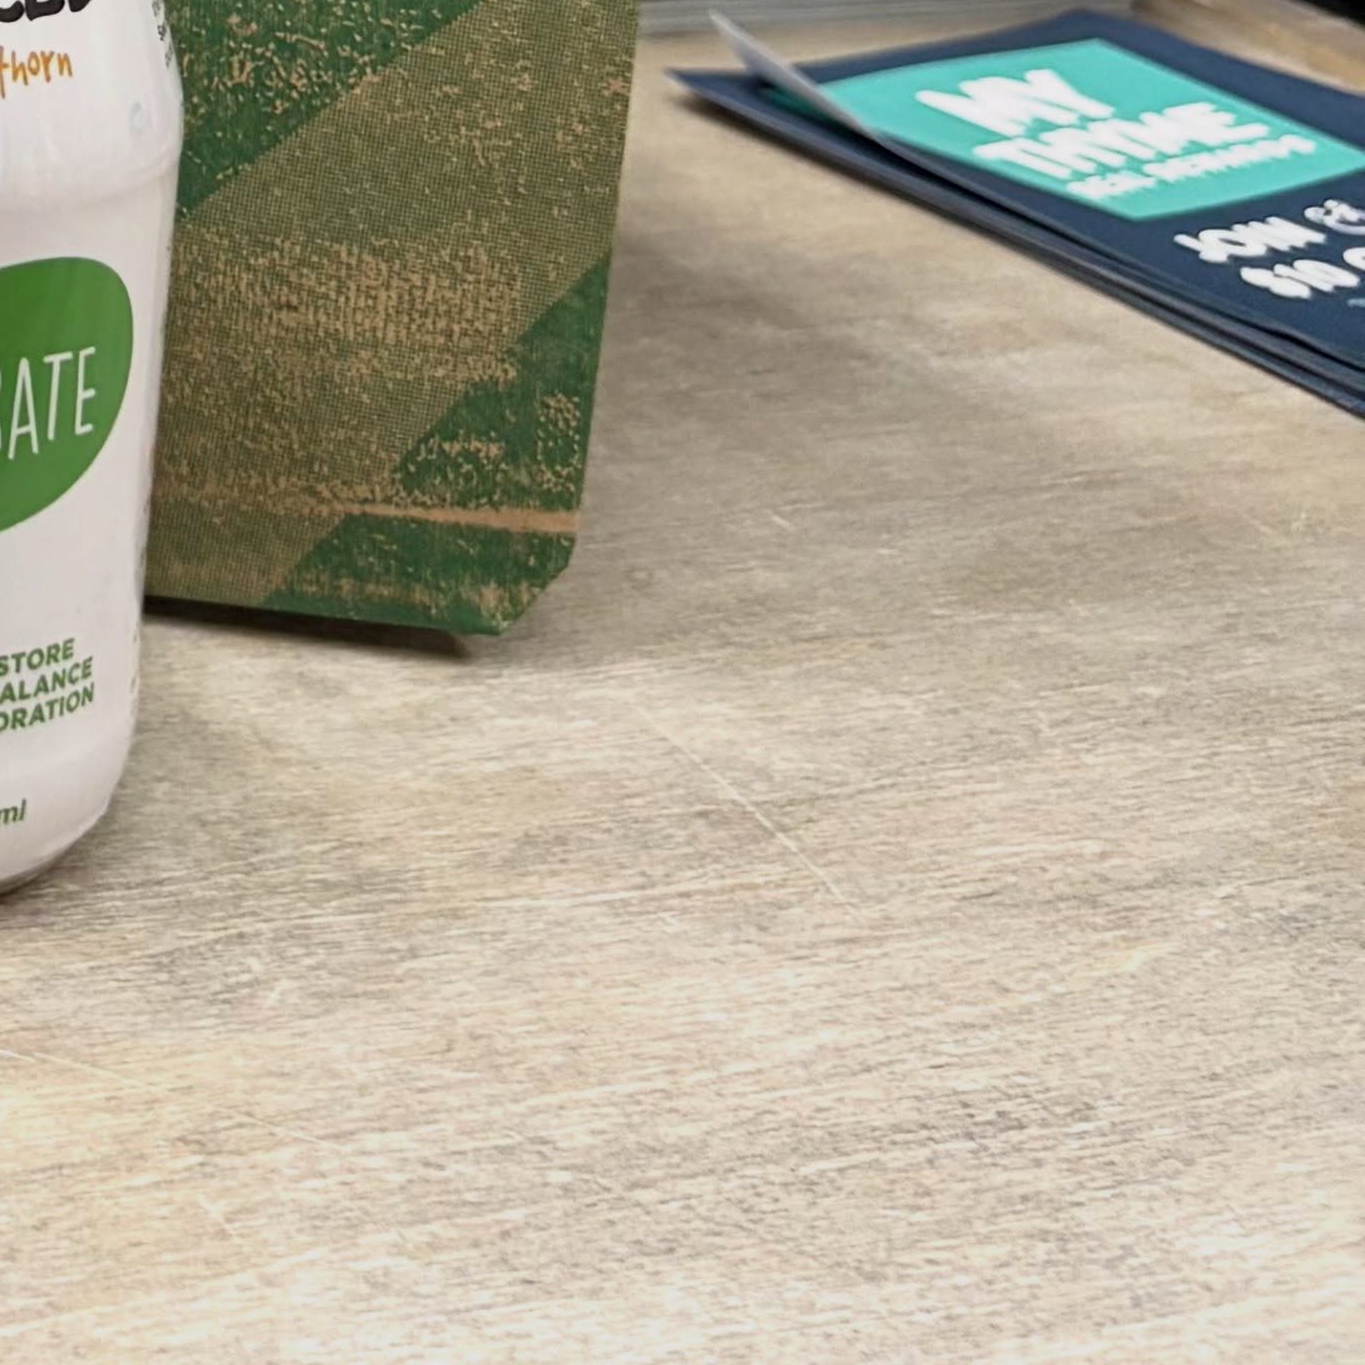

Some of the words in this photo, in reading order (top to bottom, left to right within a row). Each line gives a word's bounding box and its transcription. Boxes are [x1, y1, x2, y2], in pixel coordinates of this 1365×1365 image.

[914, 68, 1117, 138] MY
[973, 101, 1270, 180] THYME
[1173, 216, 1327, 263] JOIN
